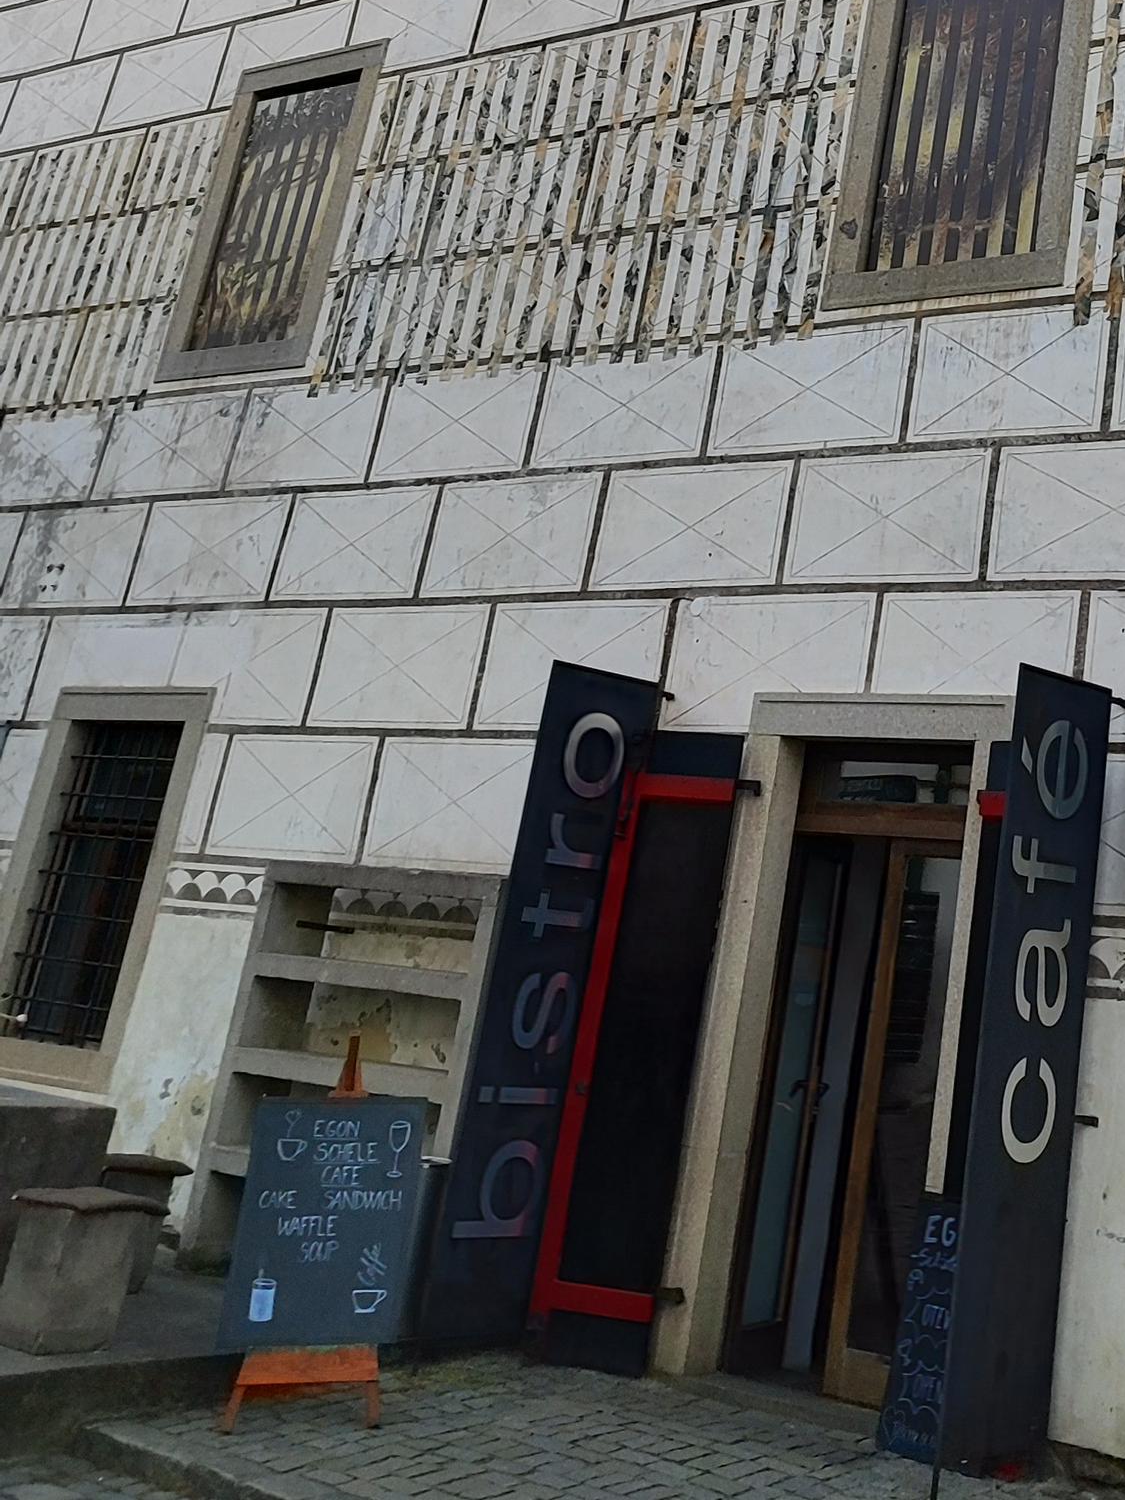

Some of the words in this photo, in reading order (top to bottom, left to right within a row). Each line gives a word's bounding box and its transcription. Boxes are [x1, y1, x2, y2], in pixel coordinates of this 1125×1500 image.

[1001, 719, 1089, 1164] café
[452, 712, 625, 1240] bistro
[313, 1119, 361, 1138] EGON
[320, 1165, 363, 1186] CAFE
[259, 1190, 298, 1209] CAKE
[324, 1188, 403, 1211] SANDWICH
[277, 1215, 339, 1236] WAFFLE
[924, 1214, 957, 1247] EG
[301, 1240, 339, 1263] SOUP
